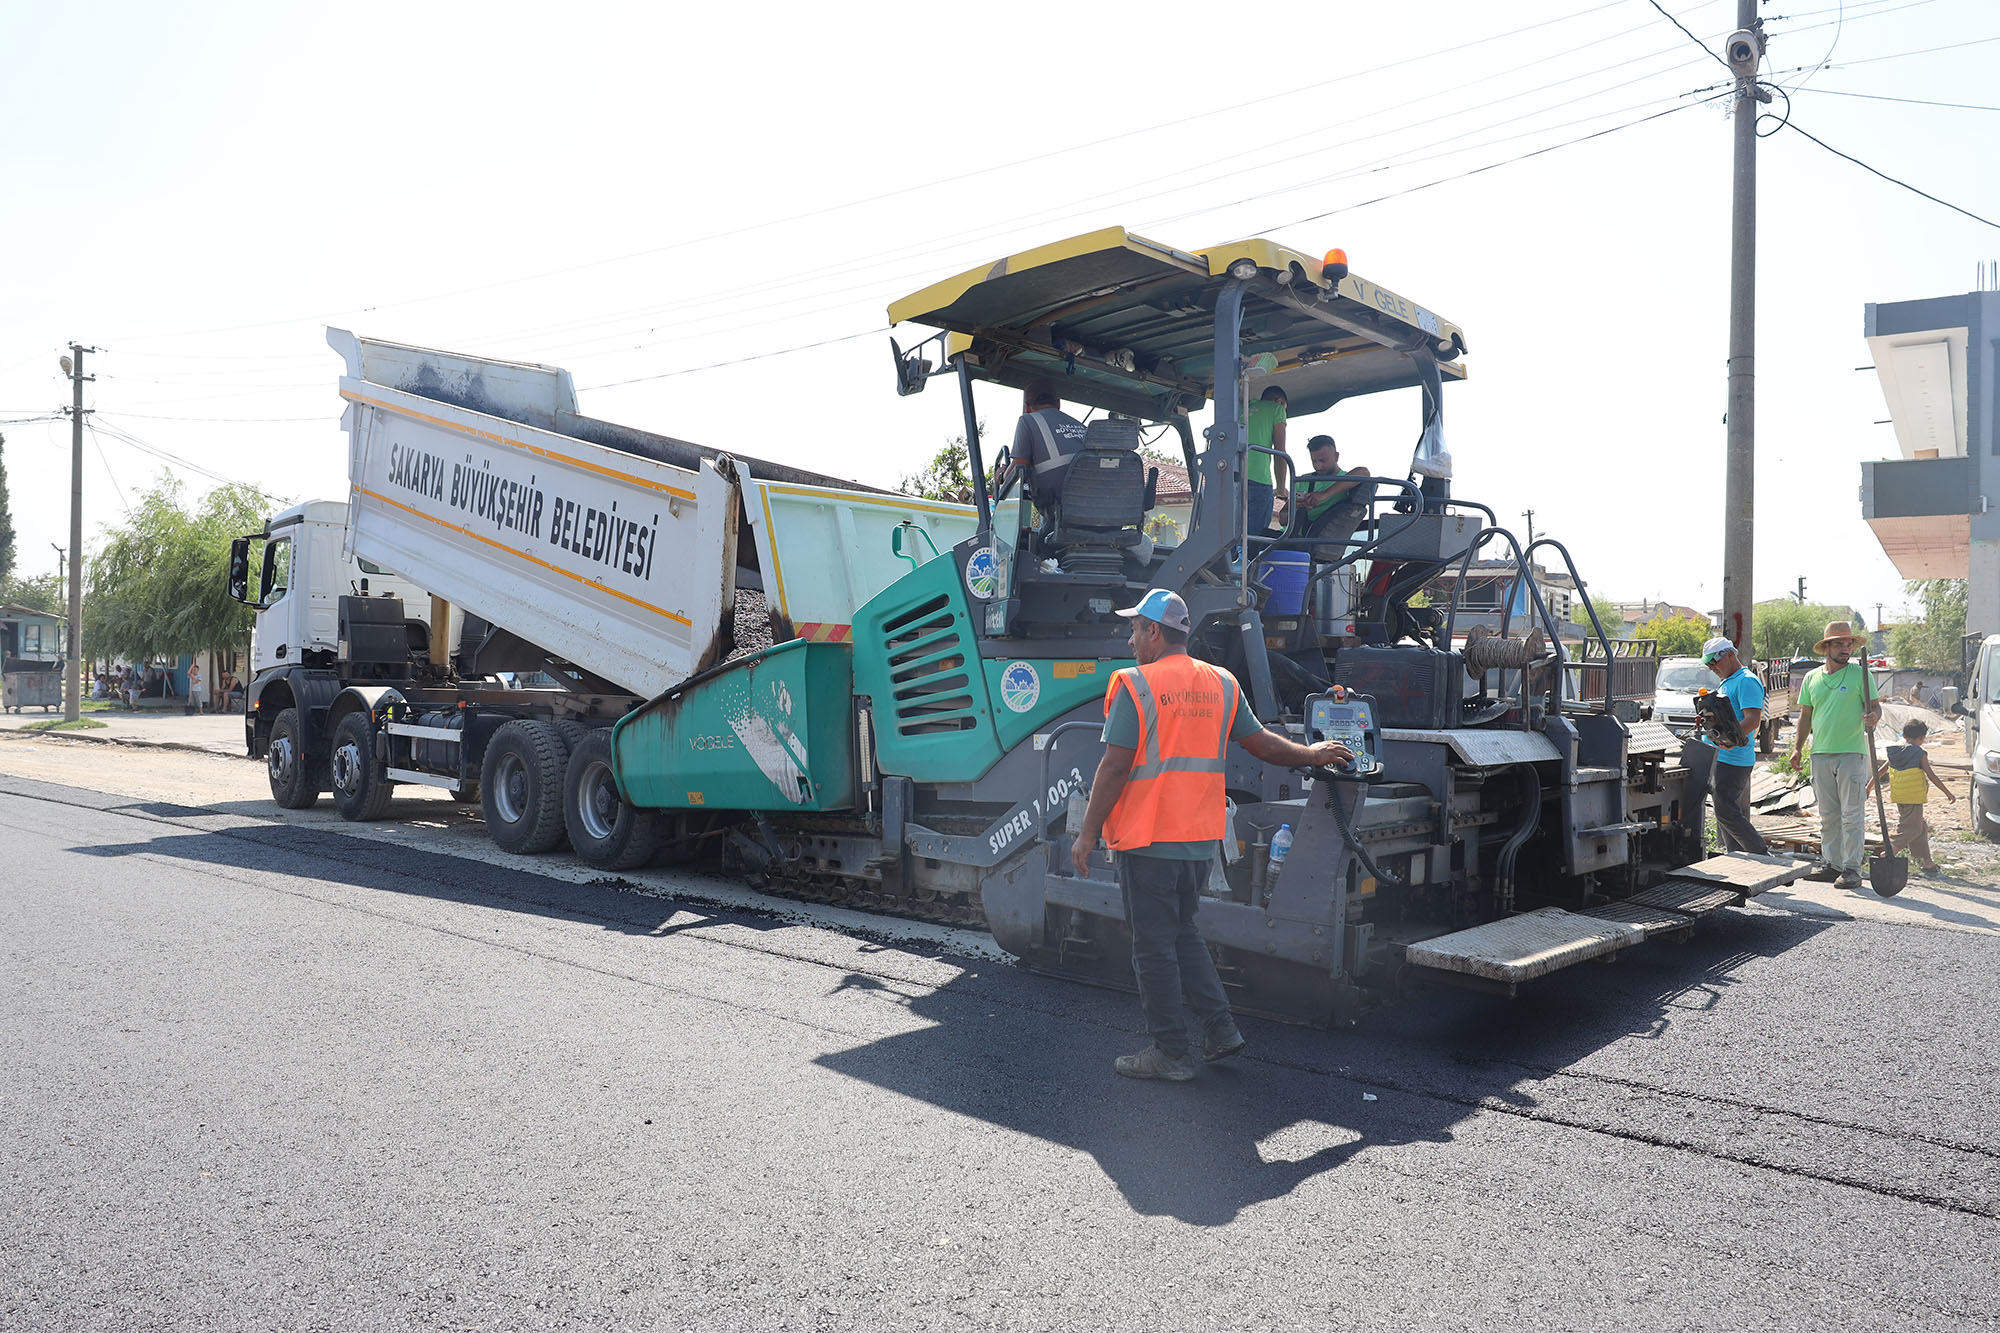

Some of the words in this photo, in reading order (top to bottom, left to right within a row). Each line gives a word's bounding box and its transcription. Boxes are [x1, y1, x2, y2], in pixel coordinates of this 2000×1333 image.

[1353, 280, 1408, 319] VGELE
[388, 442, 444, 502] SAKARYA
[450, 454, 544, 539] BÜYÜKŞEHİR
[550, 497, 659, 581] BELEDİYESİ
[689, 733, 734, 751] VÖGELE
[989, 810, 1032, 855] SUPER
[1033, 768, 1083, 816] 100-3
